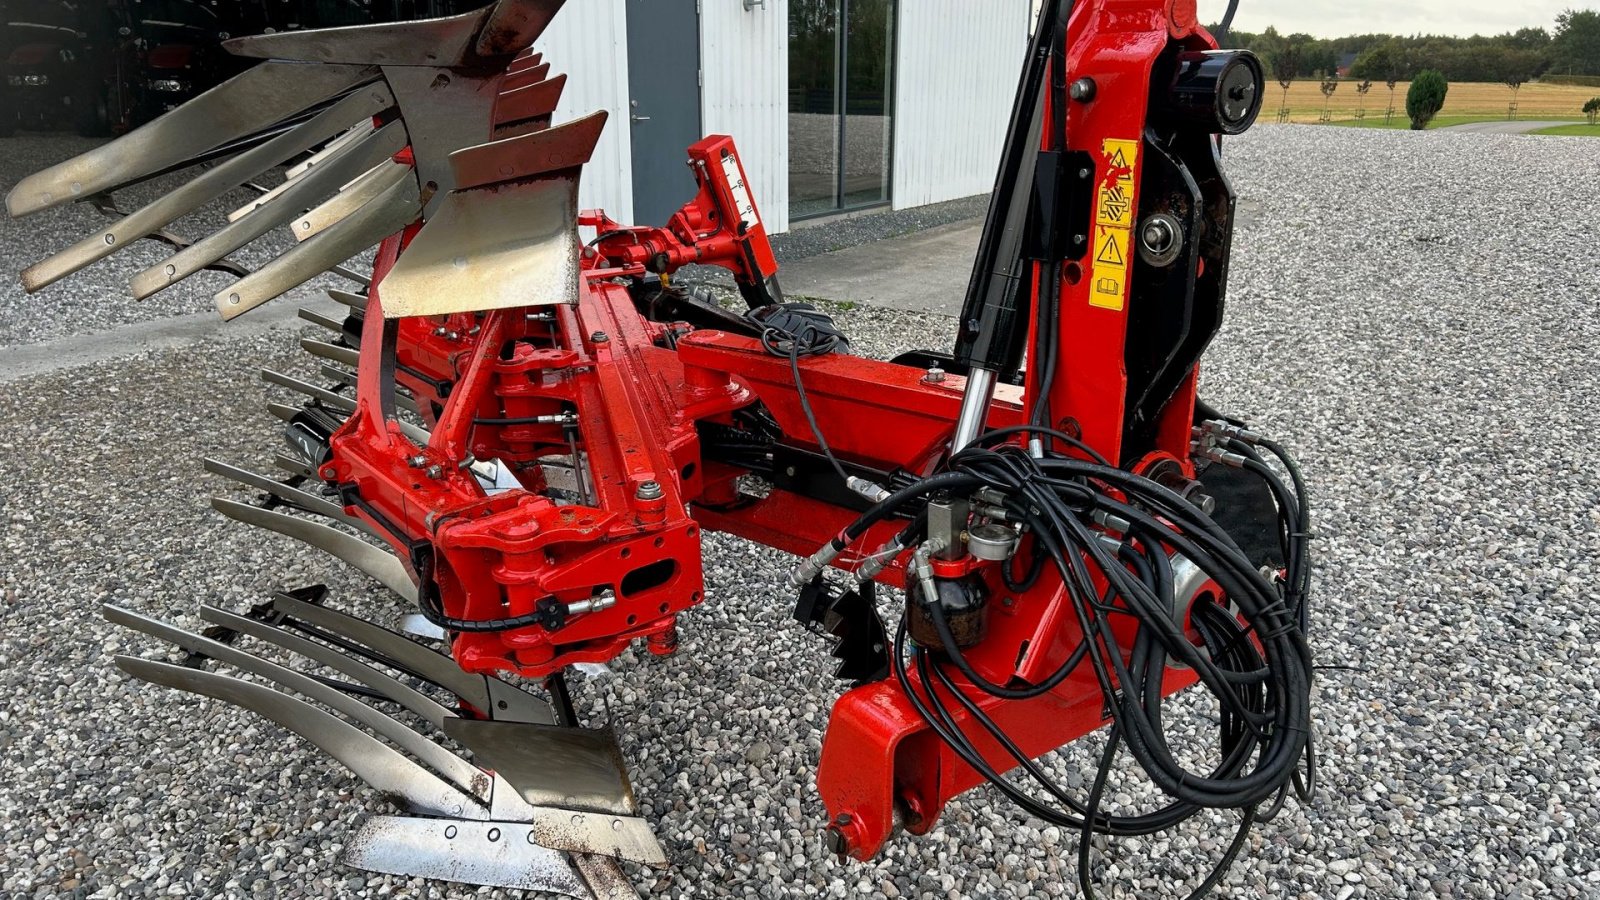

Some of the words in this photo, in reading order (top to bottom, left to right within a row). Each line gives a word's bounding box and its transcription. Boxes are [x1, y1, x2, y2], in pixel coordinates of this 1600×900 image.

[728, 154, 736, 165] 30
[736, 179, 744, 189] 20
[746, 205, 753, 214] 10
